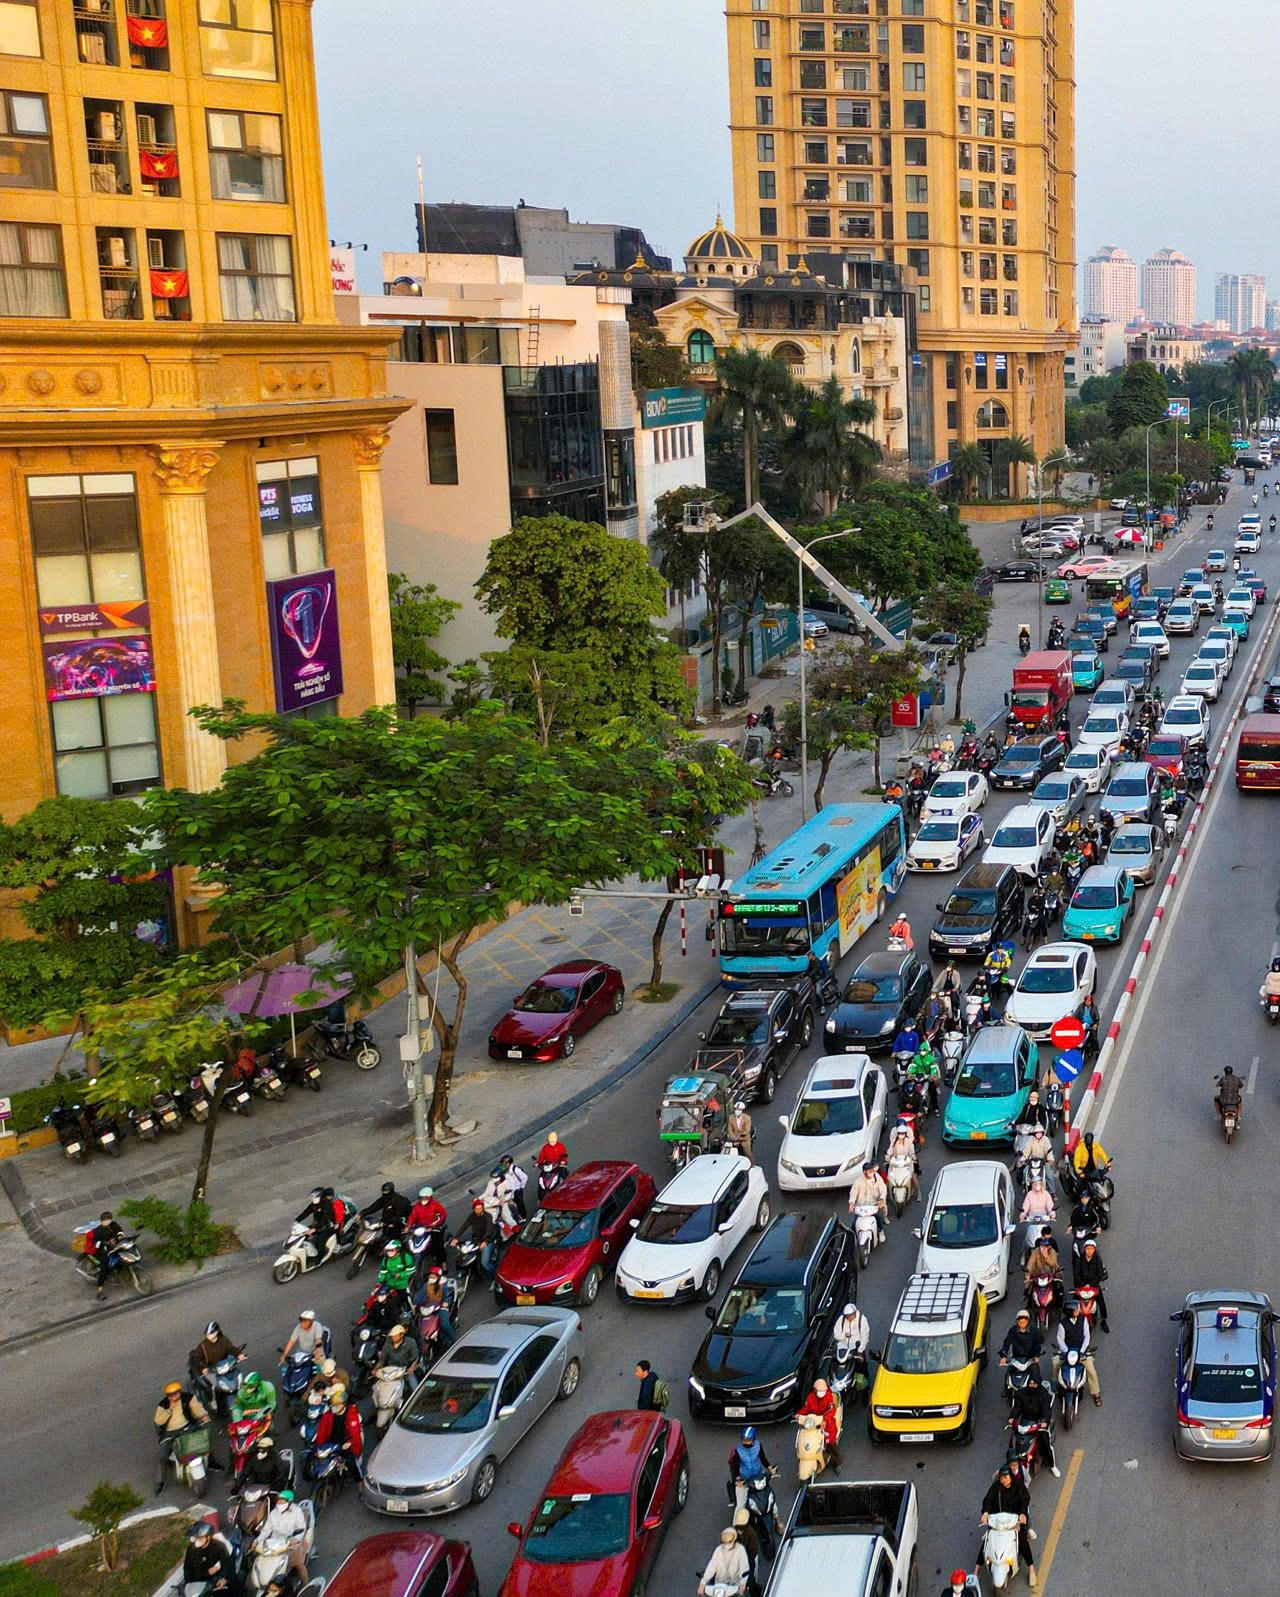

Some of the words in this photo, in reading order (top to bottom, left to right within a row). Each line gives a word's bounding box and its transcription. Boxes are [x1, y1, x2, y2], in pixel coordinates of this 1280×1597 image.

[260, 488, 277, 501] PTS
[291, 502, 313, 514] YOGA
[57, 611, 99, 623] TPBank
